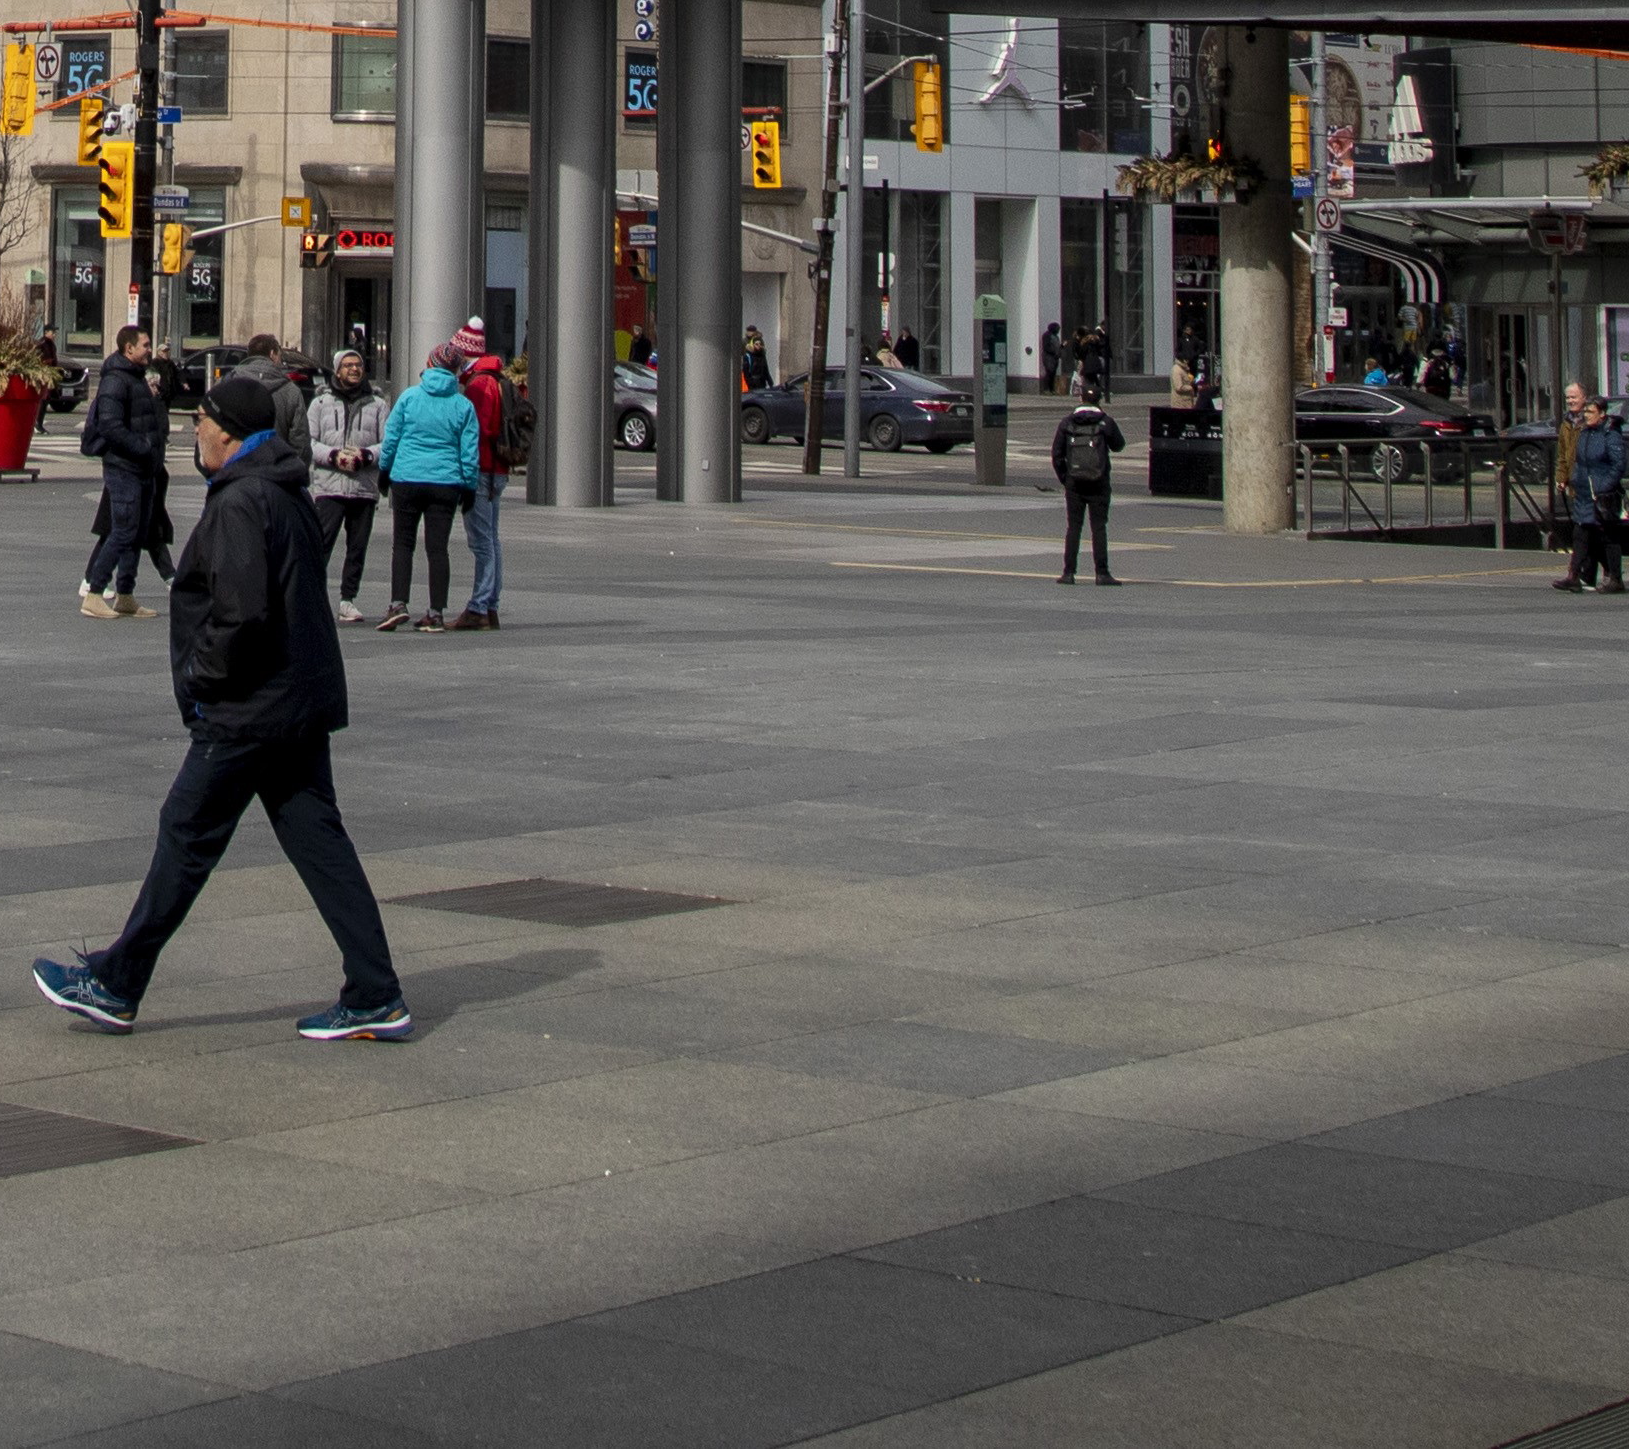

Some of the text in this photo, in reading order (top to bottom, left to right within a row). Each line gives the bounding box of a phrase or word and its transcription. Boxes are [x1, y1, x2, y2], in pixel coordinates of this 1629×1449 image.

[69, 52, 105, 63] ROGERS
[629, 65, 657, 76] ROGER
[67, 65, 105, 97] 5G
[74, 267, 93, 284] 5G
[191, 268, 212, 286] 5G
